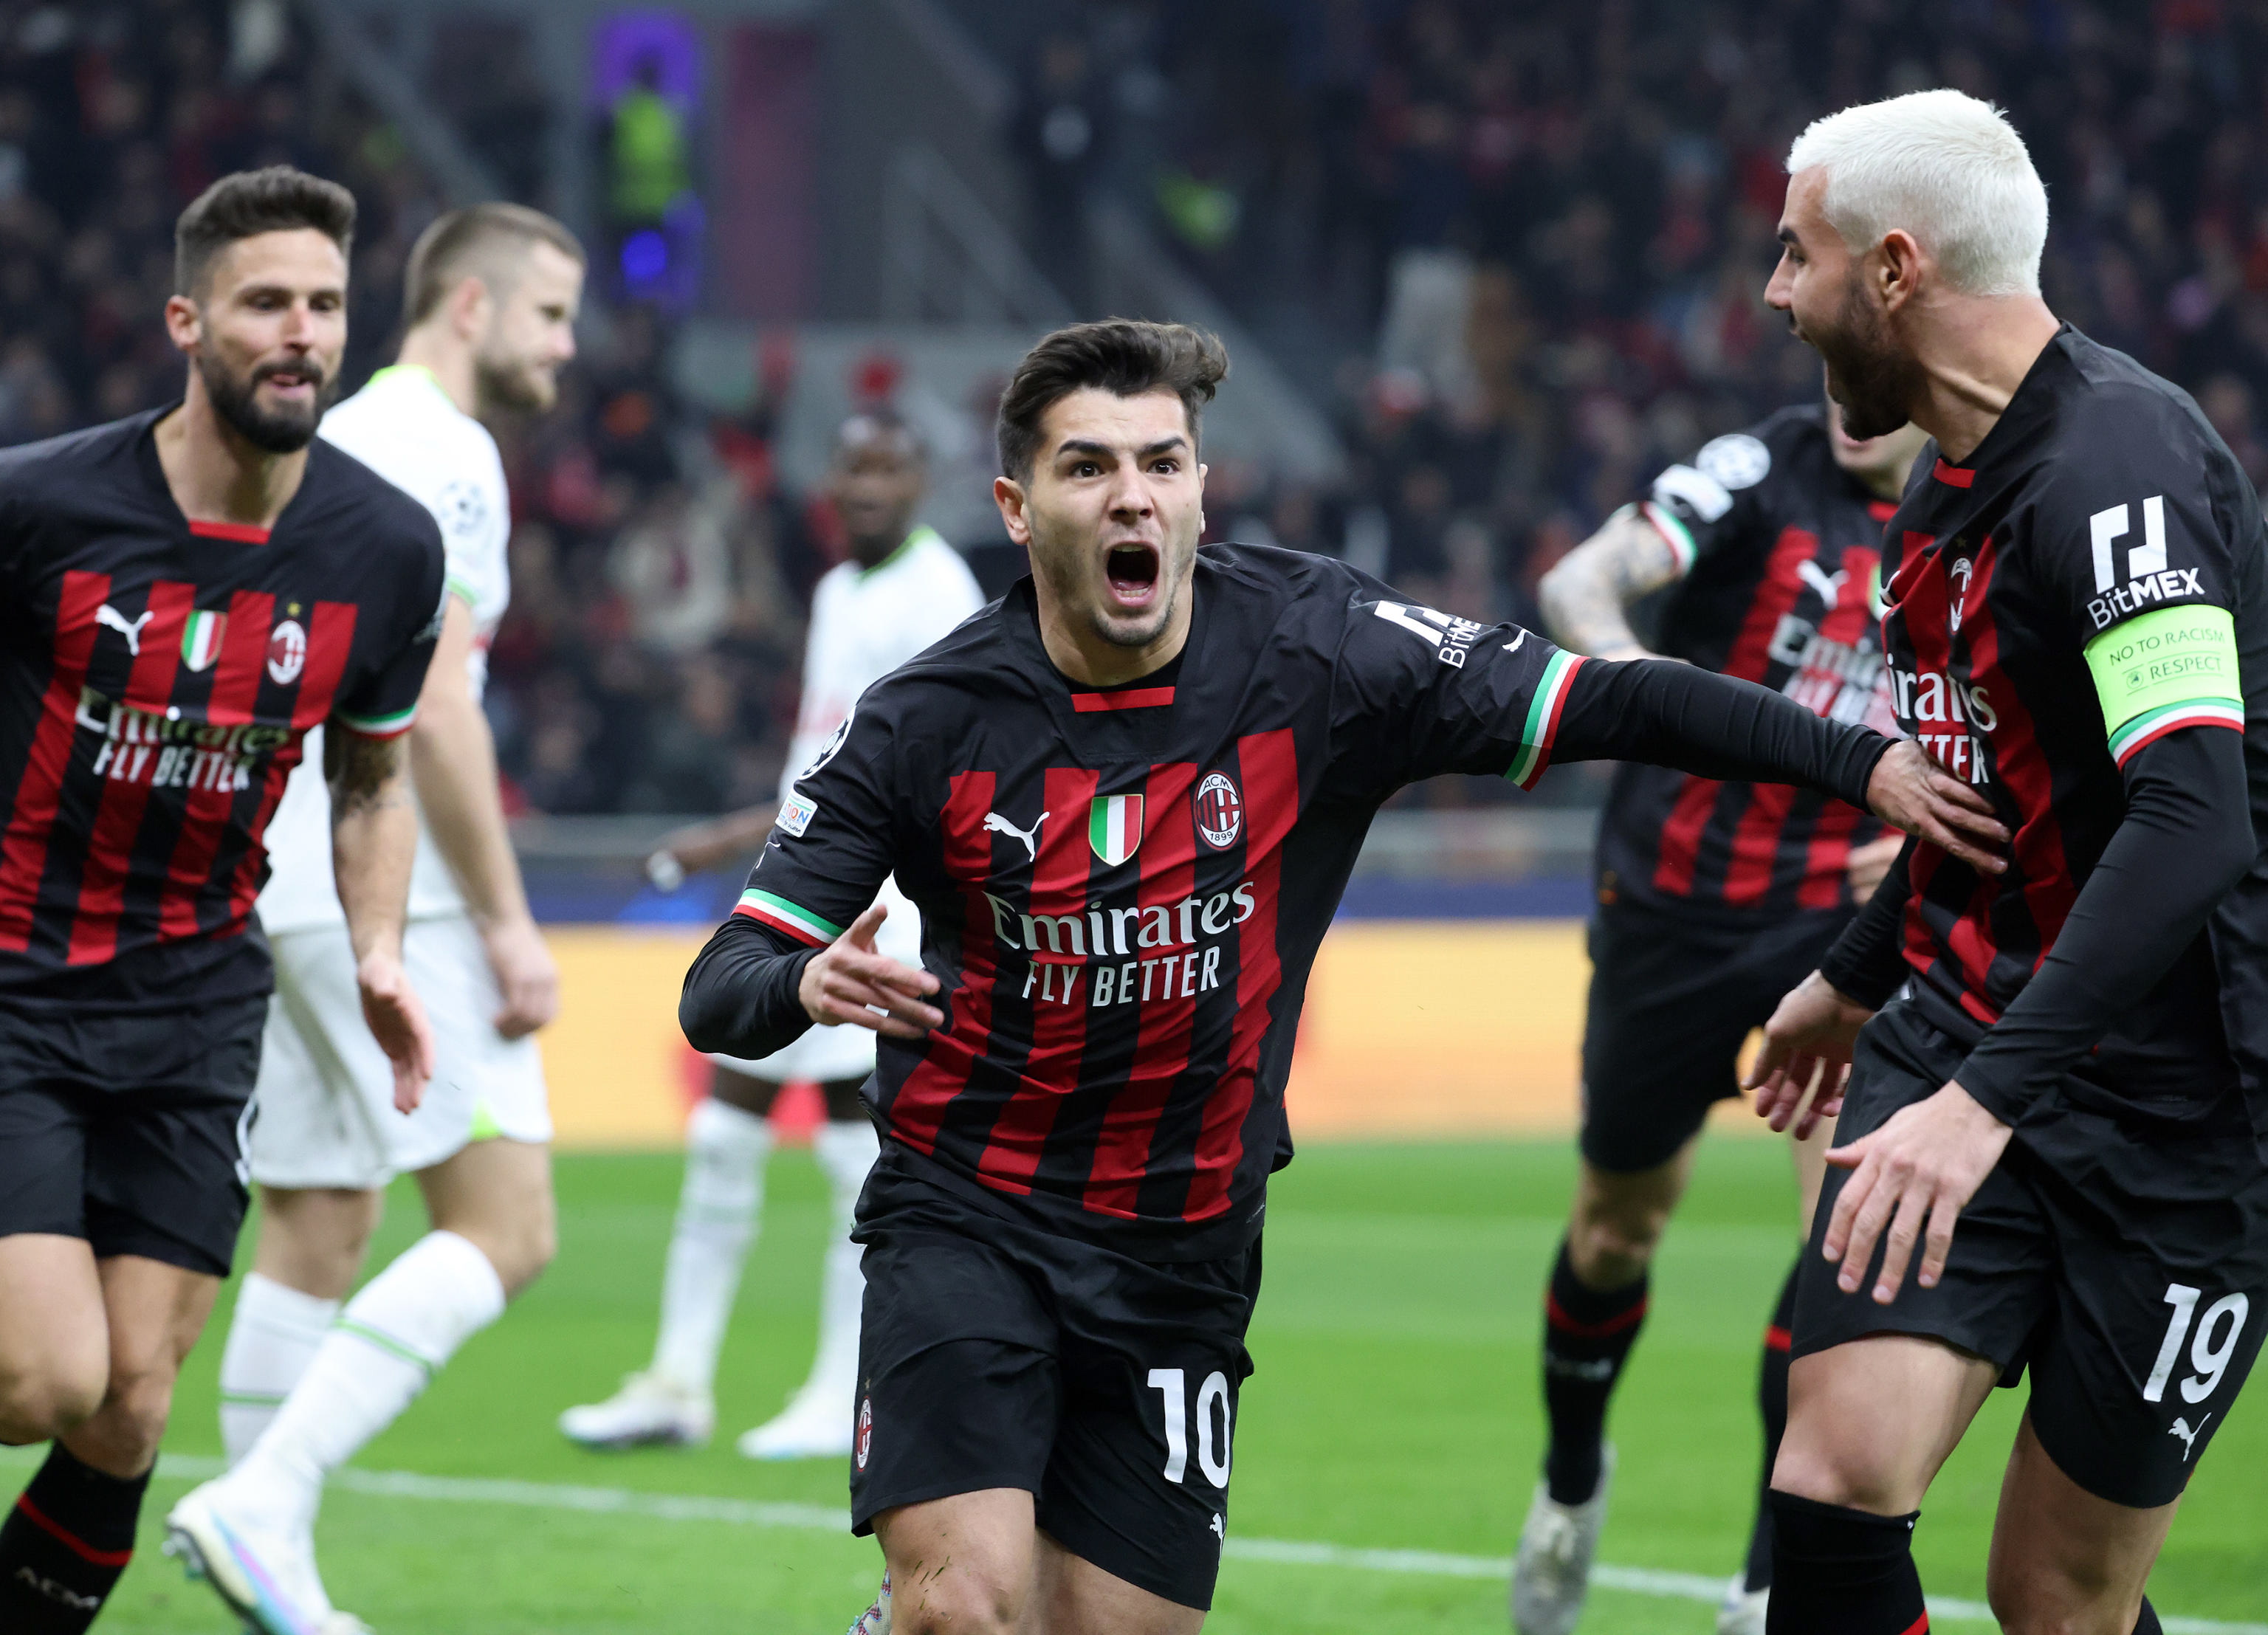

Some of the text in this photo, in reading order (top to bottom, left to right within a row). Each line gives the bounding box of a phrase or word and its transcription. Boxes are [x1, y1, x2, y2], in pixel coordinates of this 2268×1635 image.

[2086, 567, 2206, 630] BitMEX
[1438, 616, 1482, 669] BitME
[2109, 627, 2225, 667] NO TO RACISM
[2149, 656, 2221, 680] RESPECT
[1203, 776, 1230, 792] ACM
[1210, 831, 1234, 841] 1899
[981, 881, 1255, 957] Emirates
[1022, 946, 1220, 1007] FLY BETTER
[2142, 1283, 2250, 1404] 19
[1147, 1369, 1231, 1489] 10
